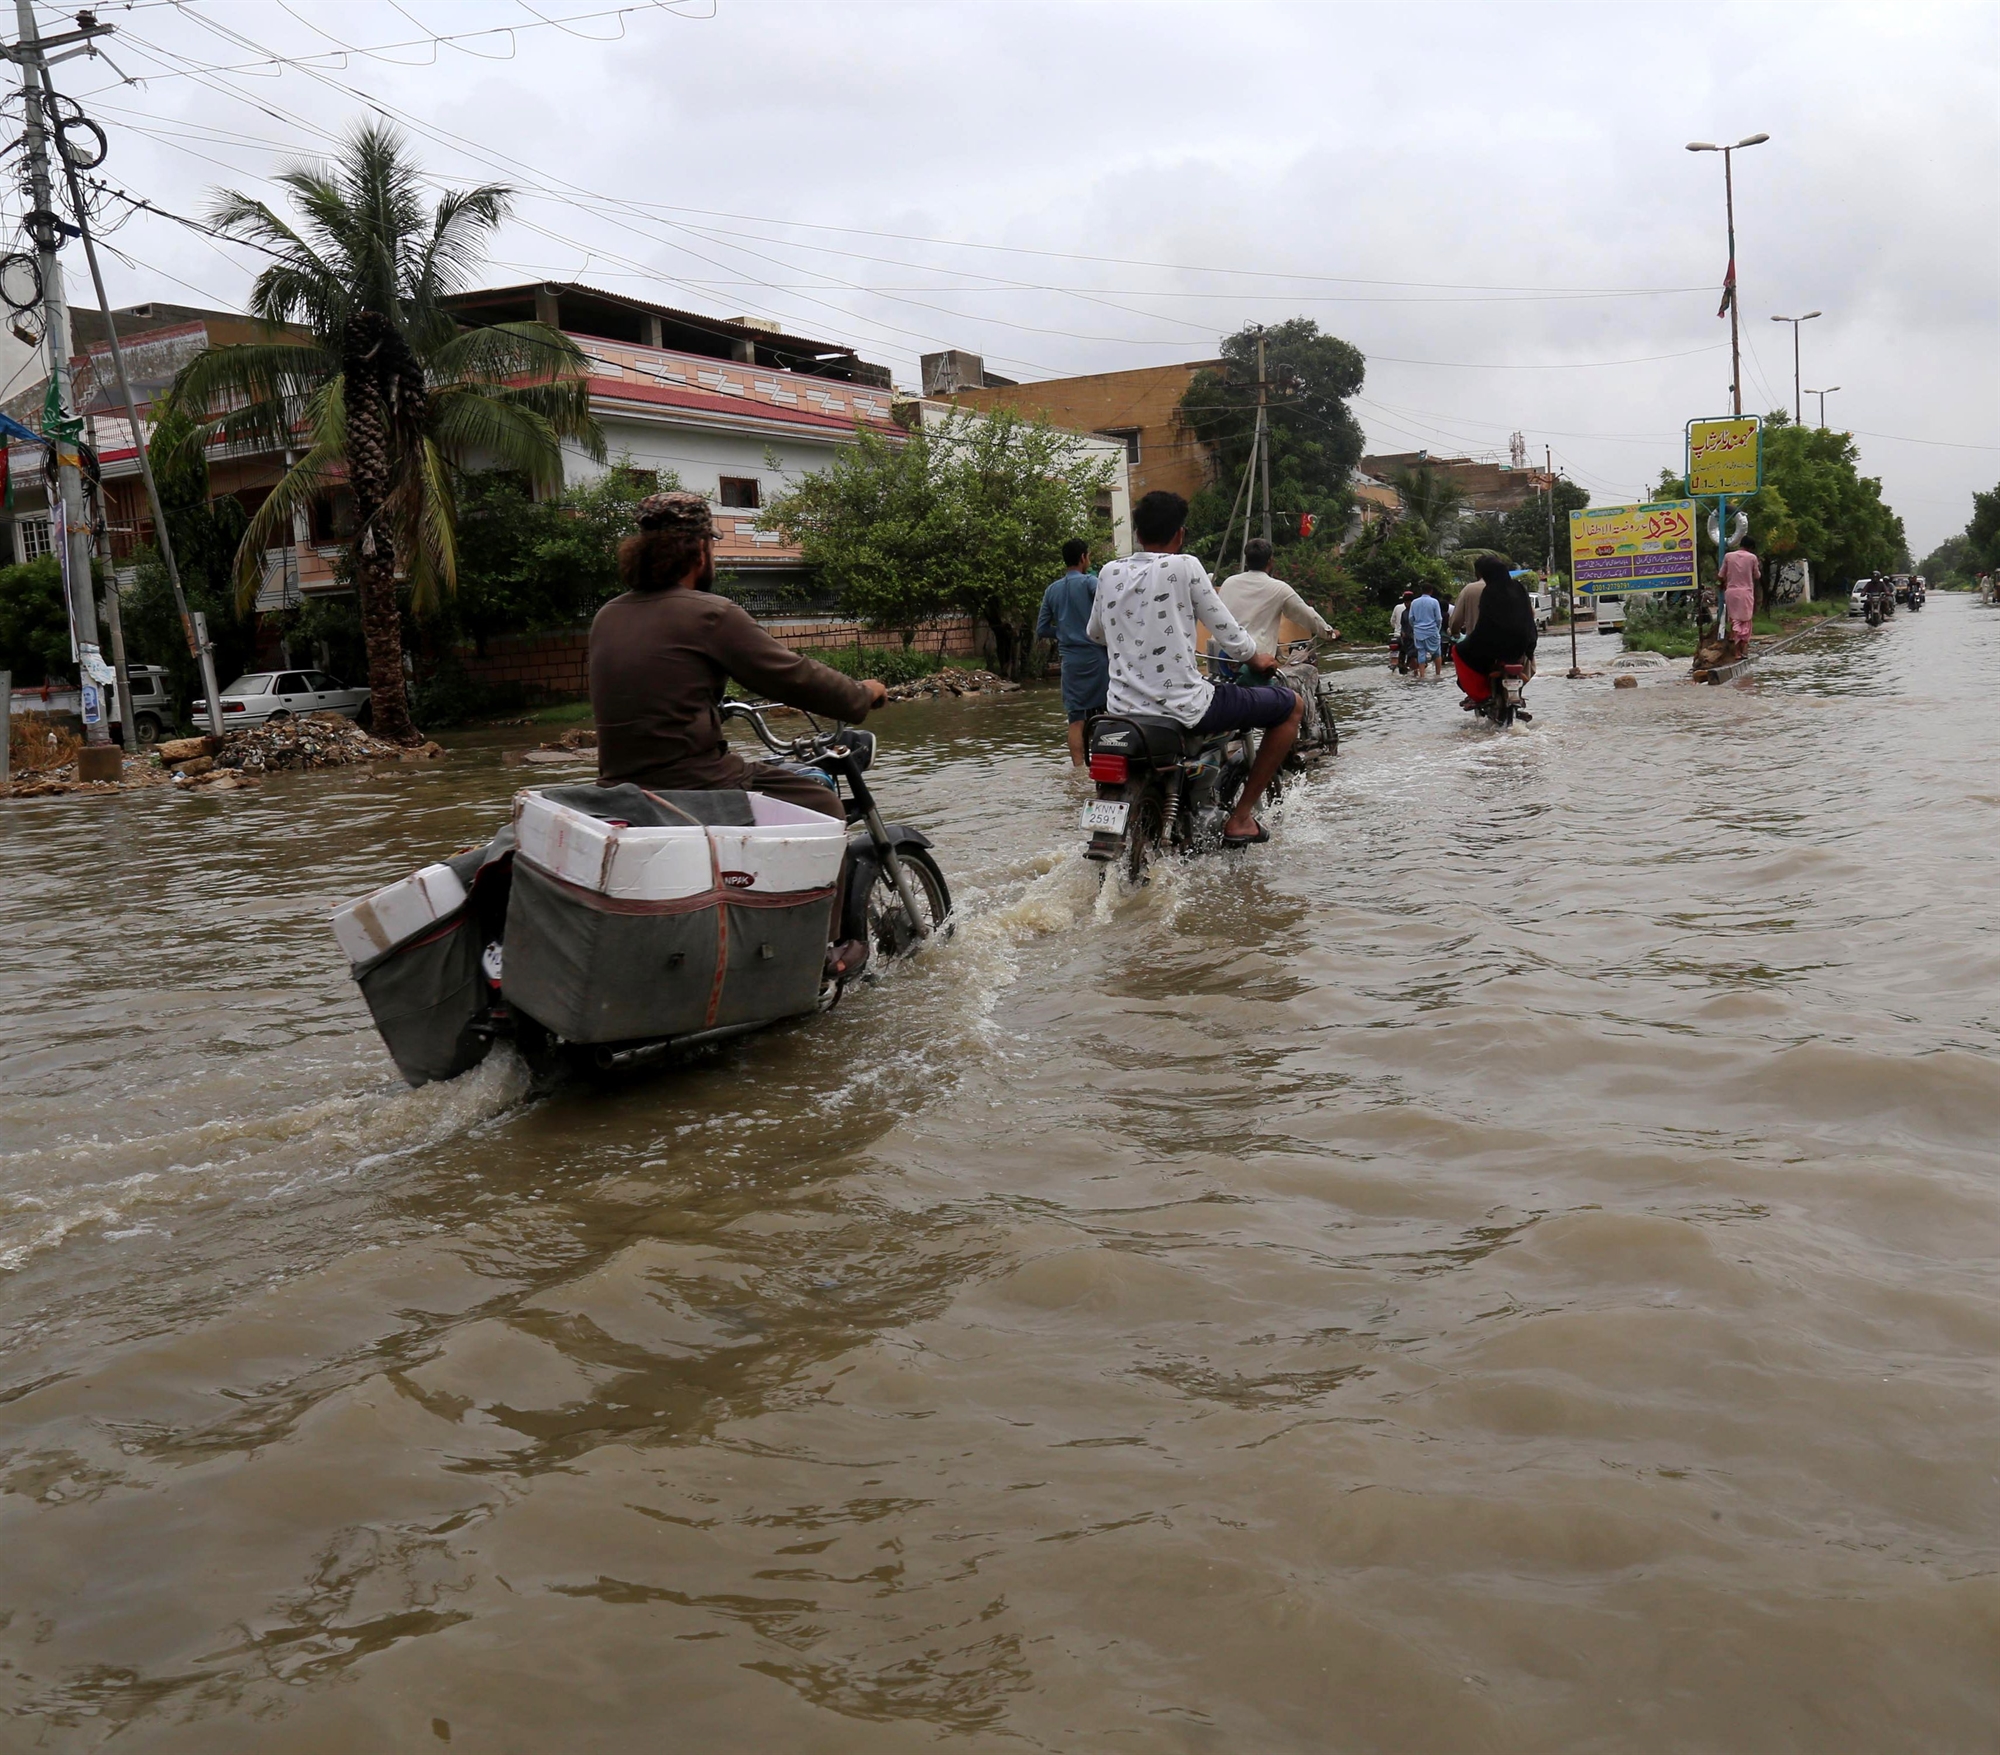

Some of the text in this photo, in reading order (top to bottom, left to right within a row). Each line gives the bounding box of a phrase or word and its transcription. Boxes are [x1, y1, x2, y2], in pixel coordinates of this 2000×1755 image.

[1719, 426, 1756, 451] مہمند
[1094, 803, 1116, 814] KNN
[1089, 813, 1116, 825] 2591
[724, 876, 750, 885] NPAK
